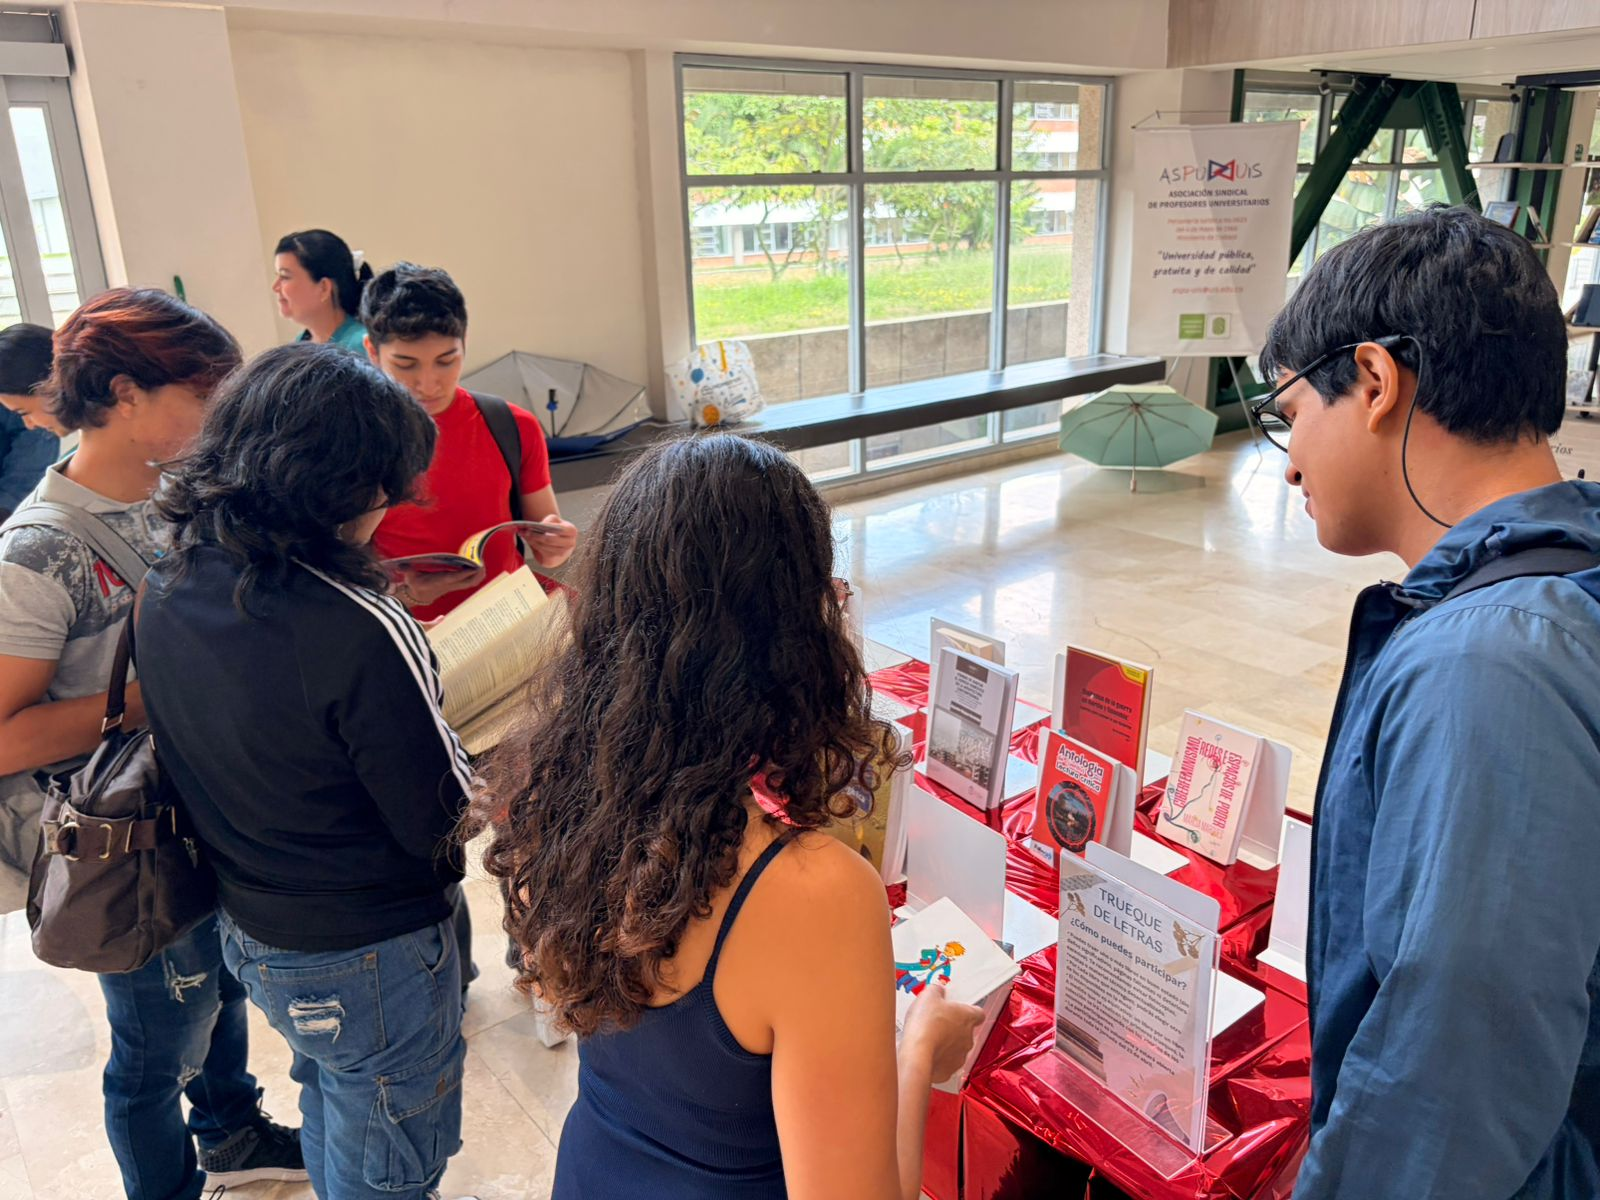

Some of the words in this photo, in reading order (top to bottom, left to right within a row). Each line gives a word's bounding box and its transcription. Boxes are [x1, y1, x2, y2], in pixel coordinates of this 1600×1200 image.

[1169, 188, 1213, 198] ASOCIACIÓN
[1215, 188, 1248, 197] SINDICAL
[1160, 200, 1207, 209] PROFESORES
[1209, 198, 1270, 208] UNIVERSITARIOS
[1217, 250, 1254, 261] pública,
[1152, 266, 1191, 278] gratuita
[1194, 268, 1201, 278] y
[1204, 266, 1215, 275] de
[1200, 741, 1223, 762] REDES
[1056, 762, 1078, 779] Lectura
[1219, 787, 1234, 802] DE
[1212, 800, 1230, 830] PODER
[1099, 888, 1162, 933] TRUEQUE
[1094, 905, 1112, 924] DE
[1114, 916, 1163, 953] LETRAS
[1070, 917, 1099, 938] ¿Cómo
[1100, 935, 1133, 960] puedes
[1135, 954, 1187, 990] participar?
